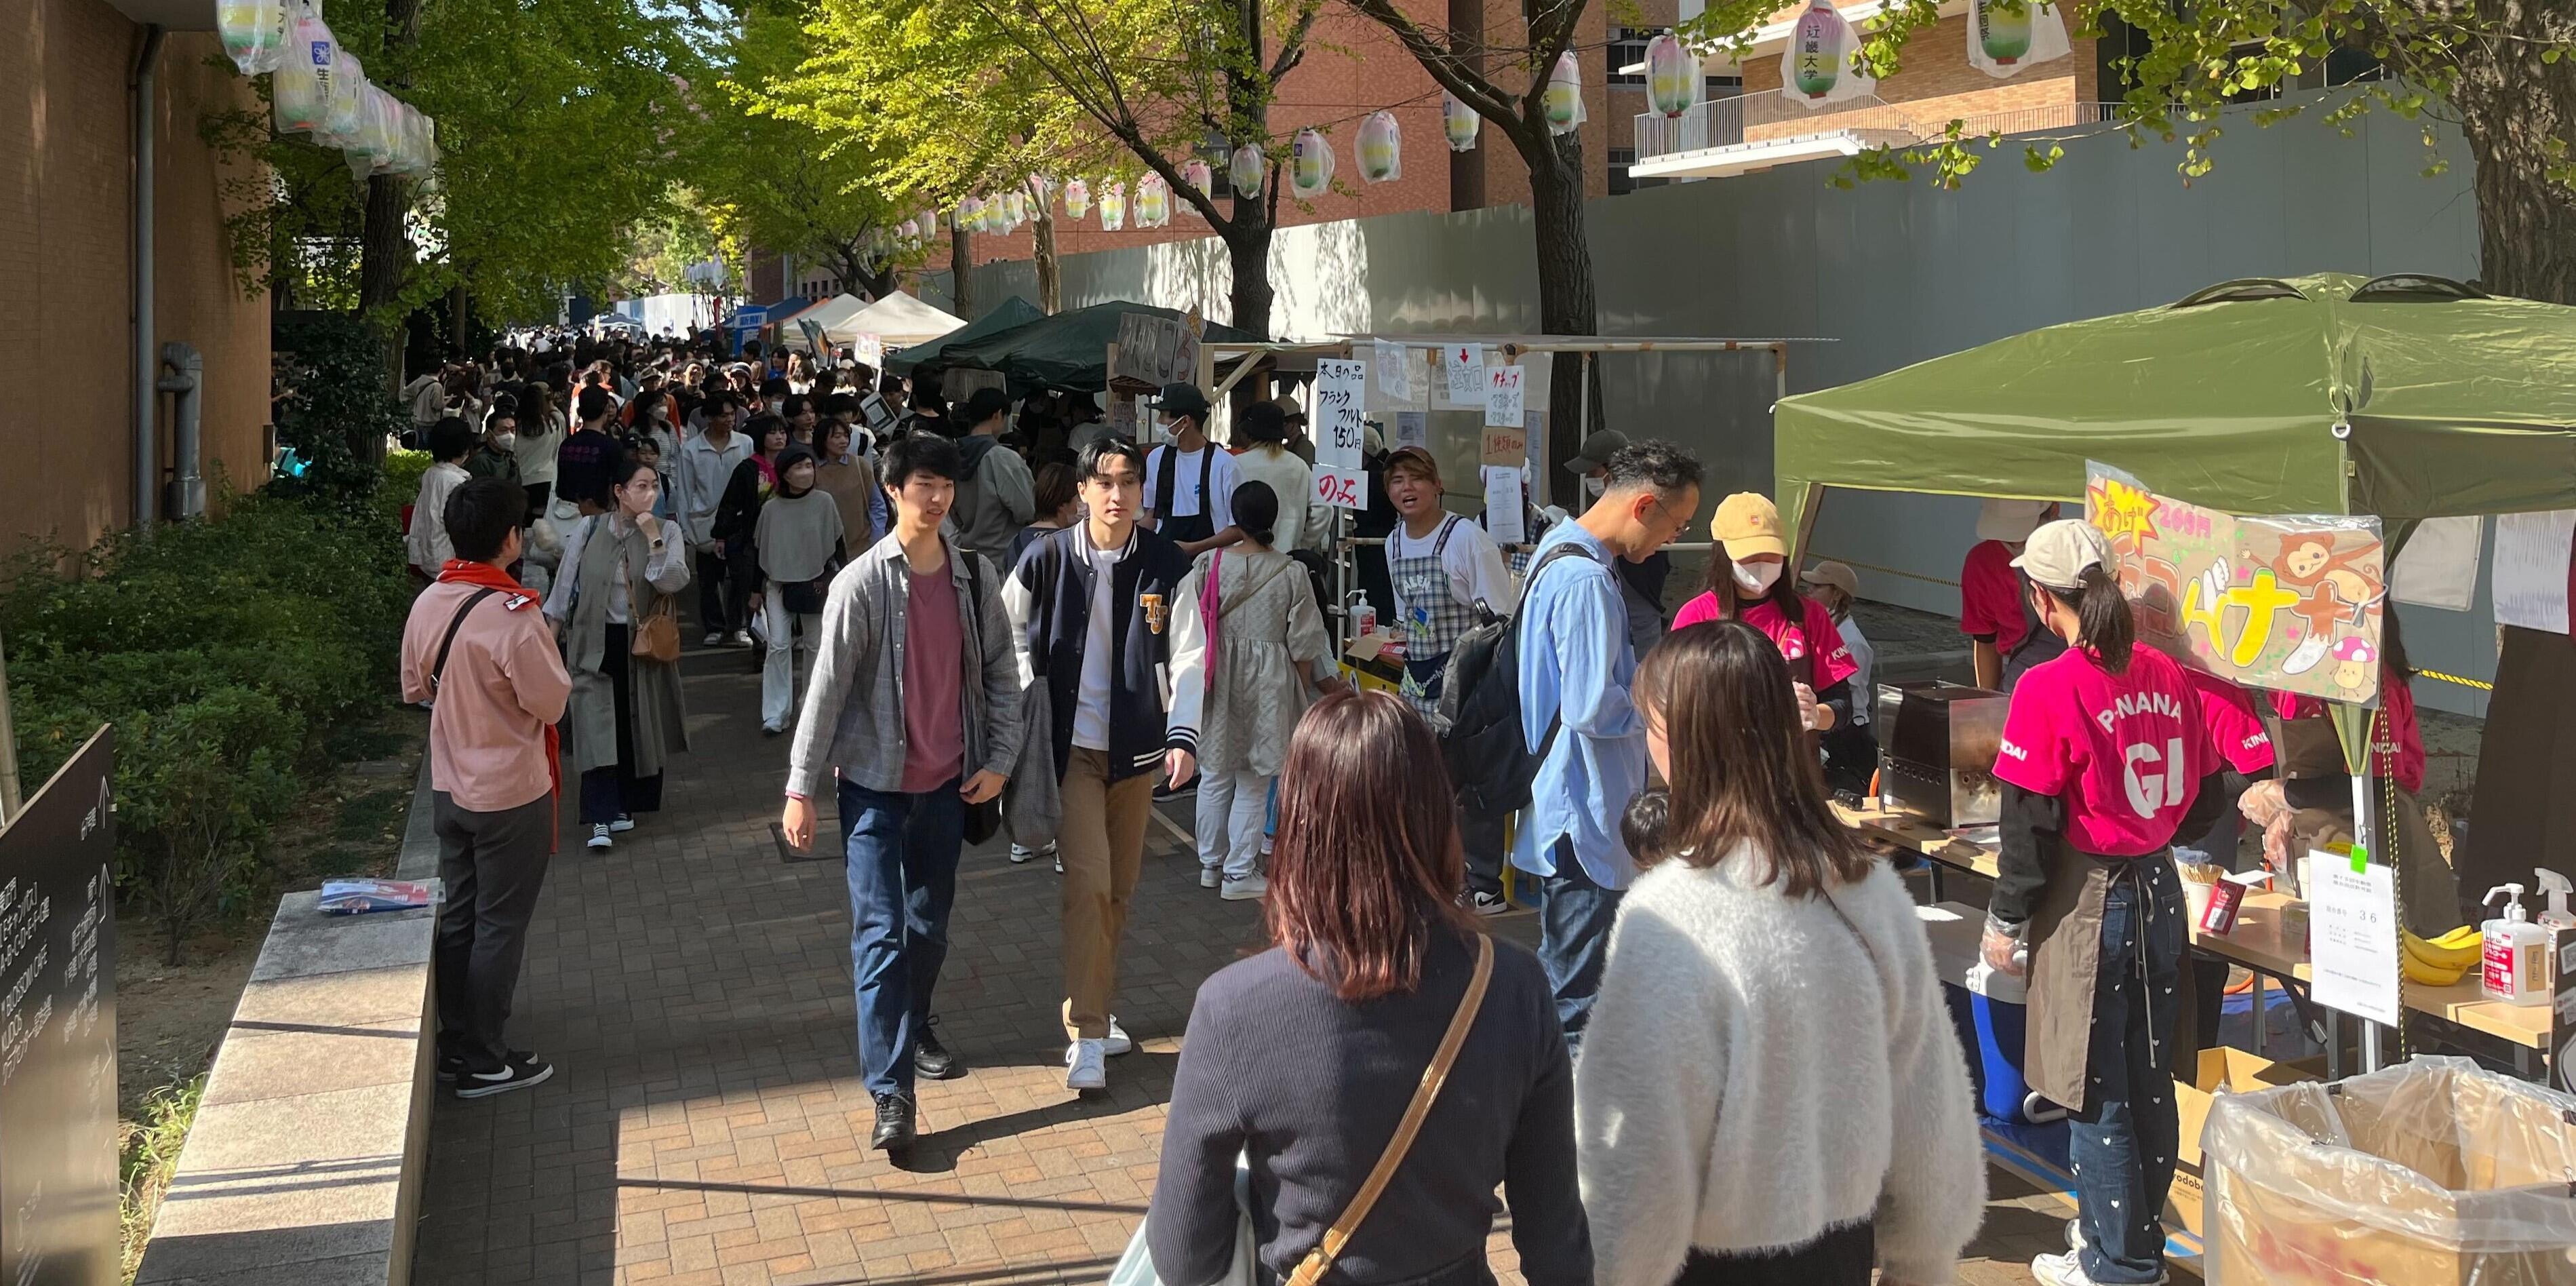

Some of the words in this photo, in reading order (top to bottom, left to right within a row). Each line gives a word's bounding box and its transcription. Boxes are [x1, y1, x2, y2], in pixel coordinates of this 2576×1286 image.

[1804, 25, 1820, 80] 近畿大学
[1320, 389, 1351, 407] フランク
[1339, 408, 1362, 428] フルト
[1333, 424, 1362, 451] 150円
[1319, 474, 1357, 507] のみ
[2103, 494, 2143, 532] あげ
[2159, 503, 2211, 539] 200円
[2097, 691, 2182, 734] P-NANA
[2124, 737, 2184, 819] GI
